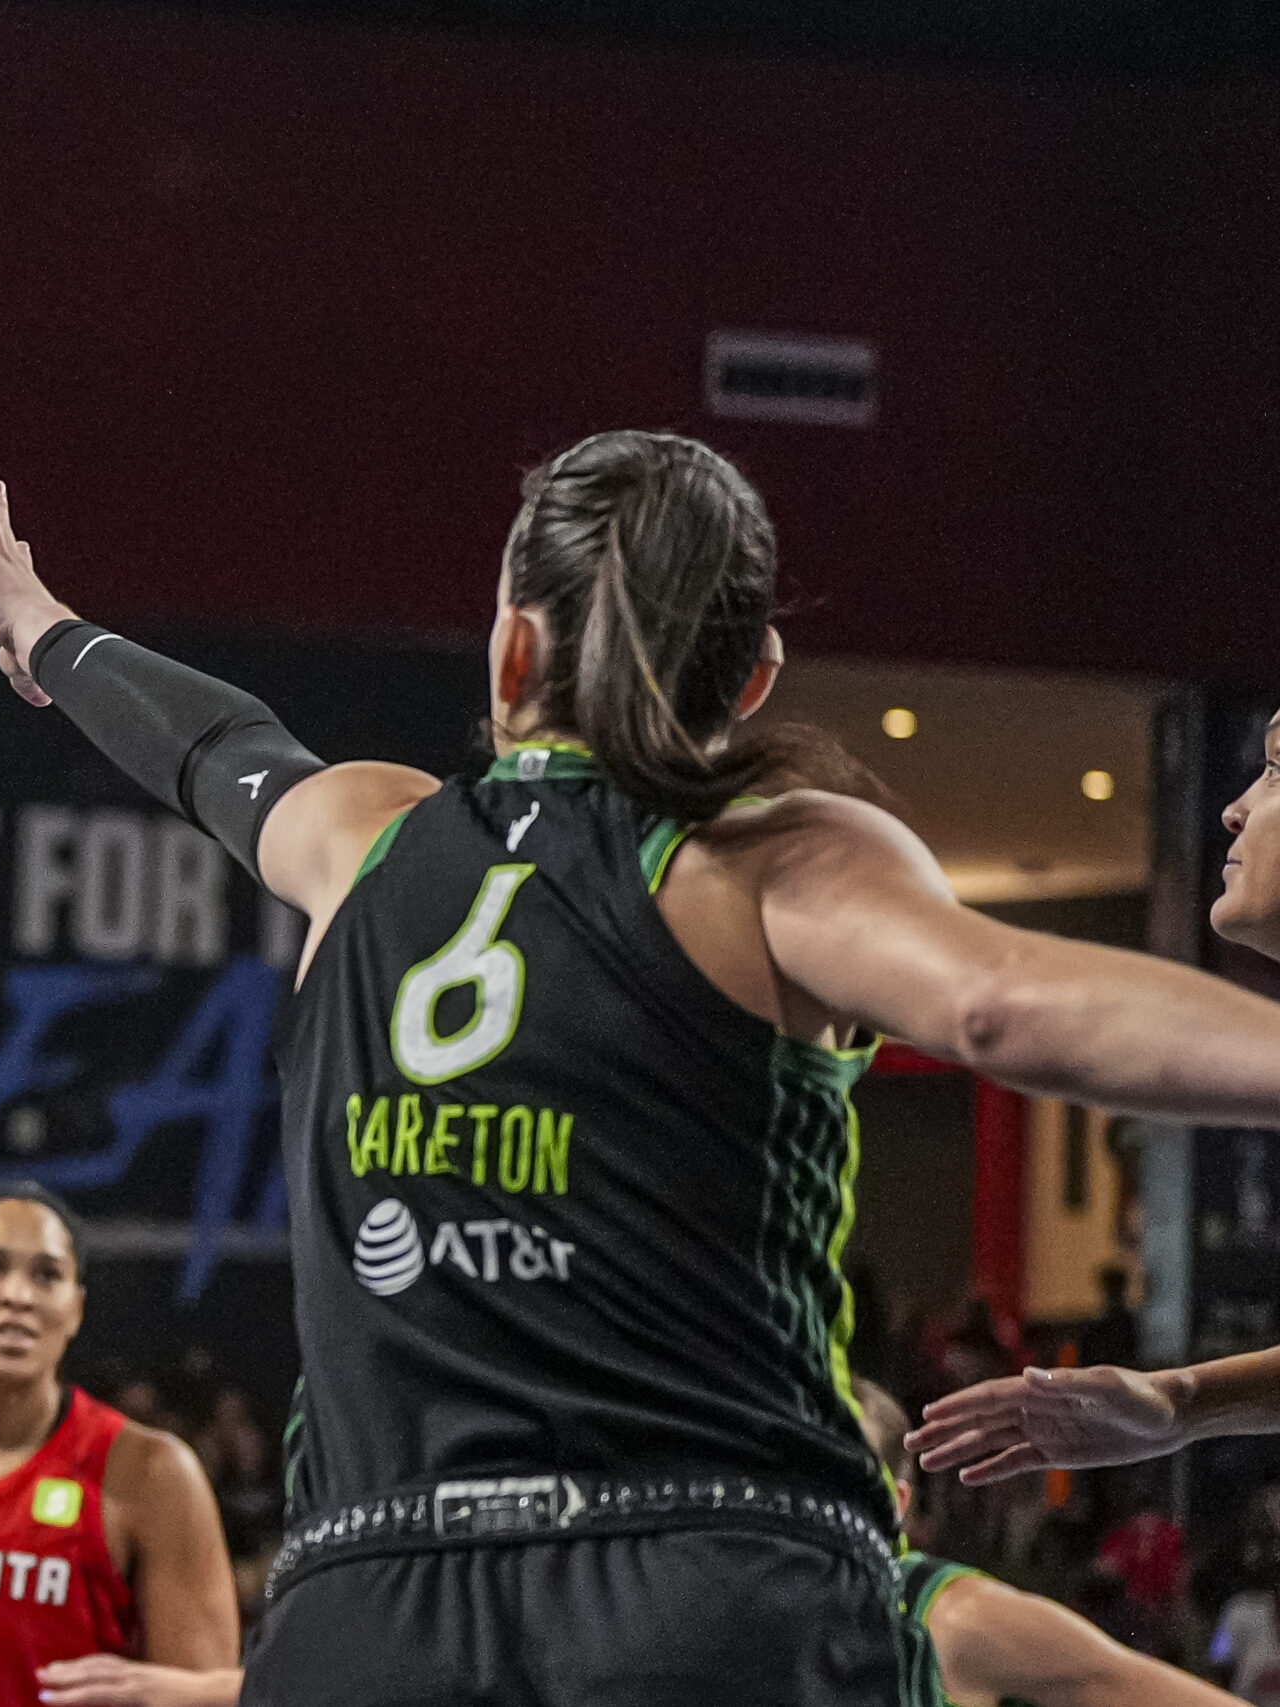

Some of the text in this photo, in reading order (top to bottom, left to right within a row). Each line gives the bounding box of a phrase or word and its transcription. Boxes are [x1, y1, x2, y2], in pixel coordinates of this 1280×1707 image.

[17, 805, 224, 962] FOR
[390, 863, 536, 1085] 6
[429, 1217, 576, 1283] AT&T
